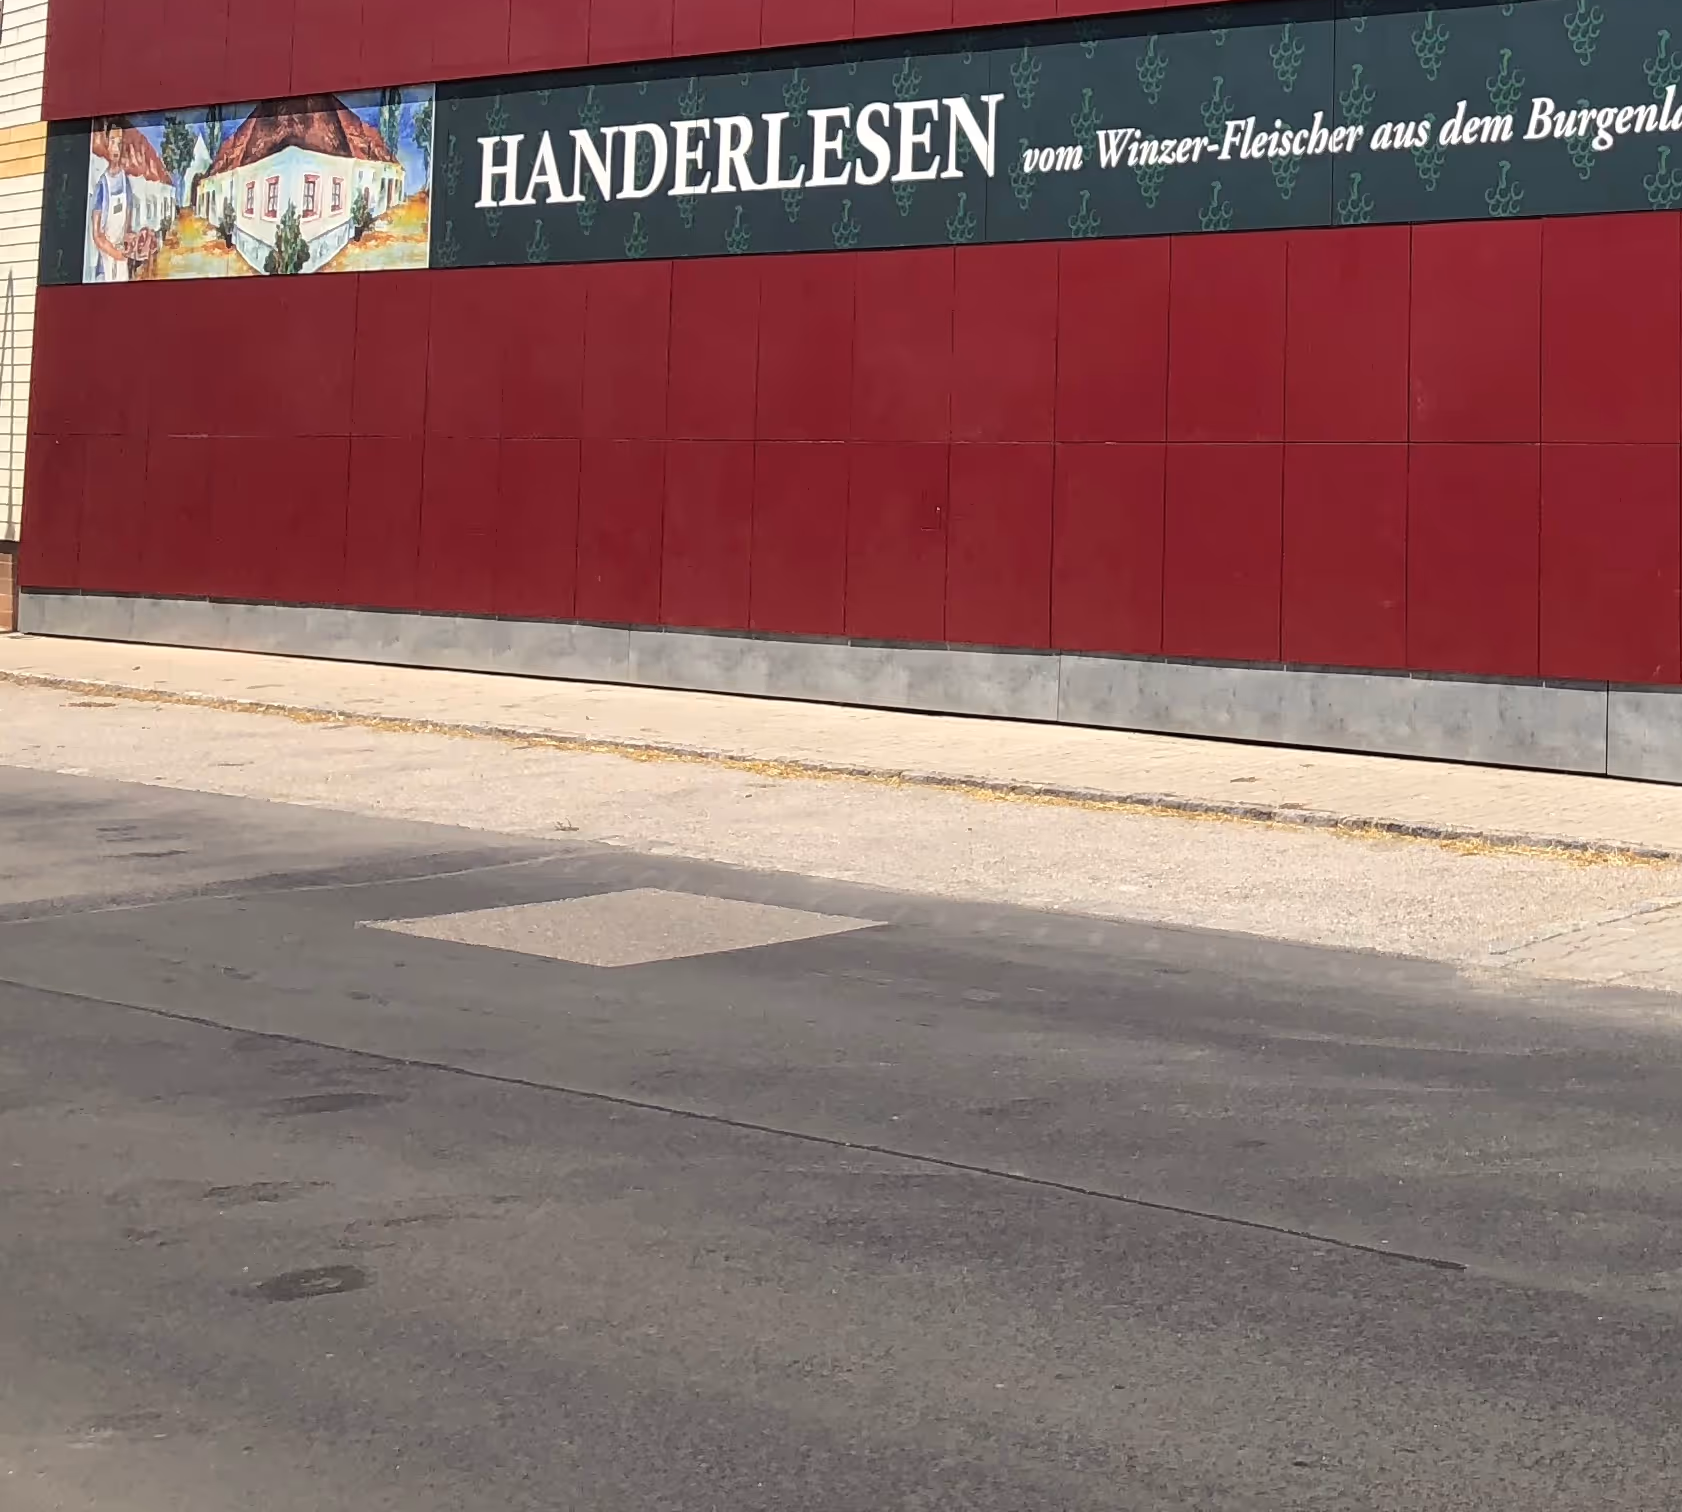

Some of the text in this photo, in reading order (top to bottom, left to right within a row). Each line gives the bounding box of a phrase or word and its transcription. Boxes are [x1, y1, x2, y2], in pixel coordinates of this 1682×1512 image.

[474, 93, 1005, 208] HANDERLESEN
[1021, 144, 1084, 173] vom
[1095, 111, 1364, 169] Winzer-Fleischer
[1369, 117, 1431, 151] aus
[1438, 100, 1514, 146] dem
